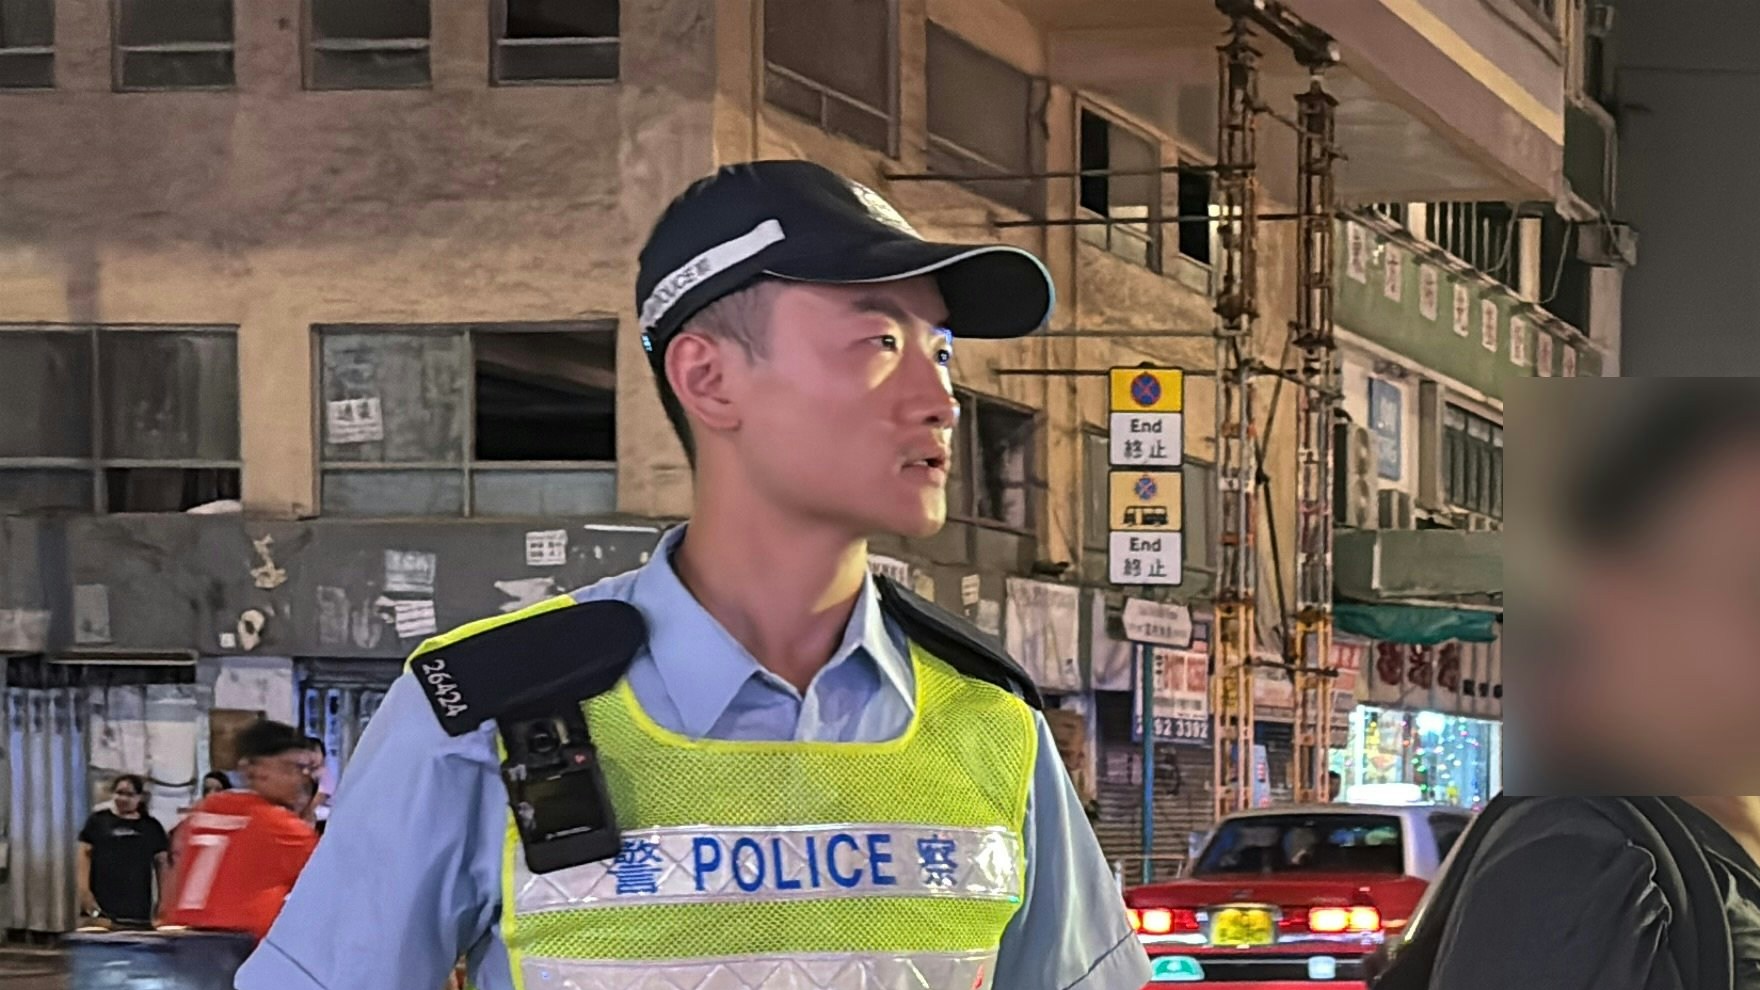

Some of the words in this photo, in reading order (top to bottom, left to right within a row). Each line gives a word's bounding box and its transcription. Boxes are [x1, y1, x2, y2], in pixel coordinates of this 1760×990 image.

[1130, 418, 1163, 434] End
[1123, 439, 1168, 459] 終止
[1129, 537, 1162, 553] End
[1123, 557, 1168, 577] 終止
[421, 658, 469, 717] 26424
[607, 838, 664, 896] 警
[693, 833, 898, 893] POLICE
[916, 834, 958, 888] 察
